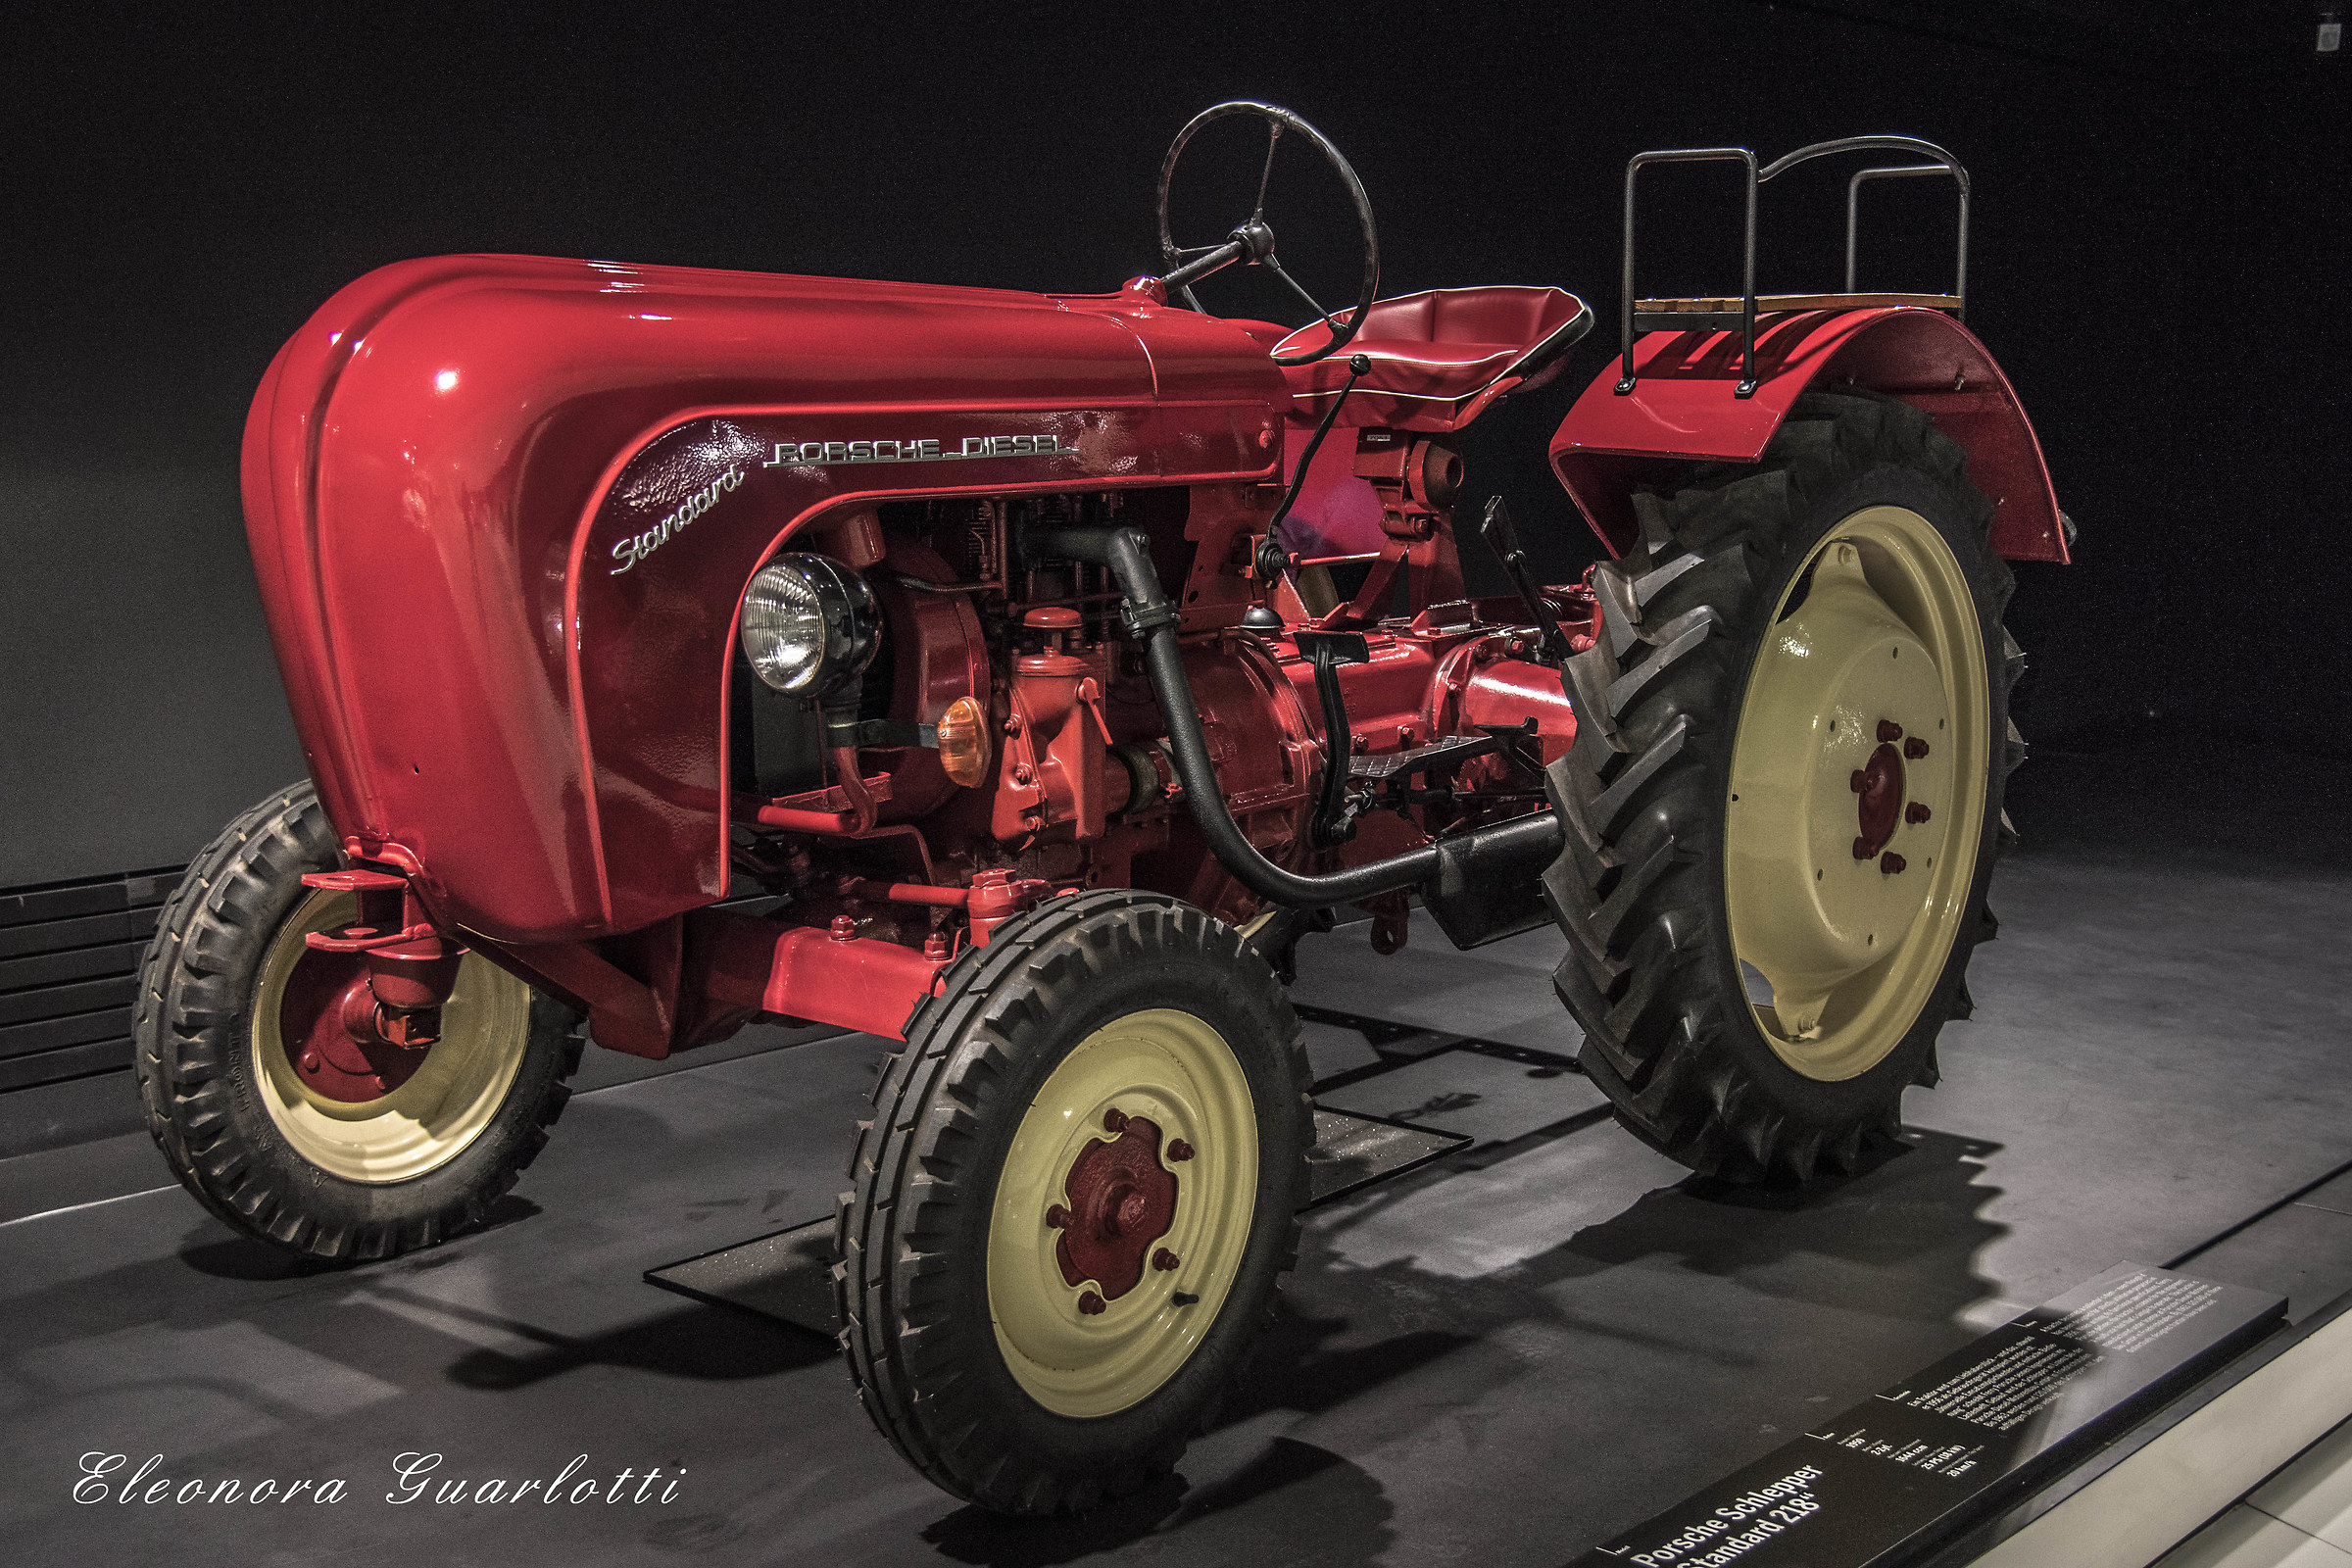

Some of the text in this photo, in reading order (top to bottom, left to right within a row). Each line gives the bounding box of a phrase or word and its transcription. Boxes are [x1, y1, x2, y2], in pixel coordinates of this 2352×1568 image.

[774, 434, 1066, 464] PORSCHE DIESEL
[612, 465, 745, 574] Standard
[1631, 1464, 1823, 1568] Porsche Schlepper
